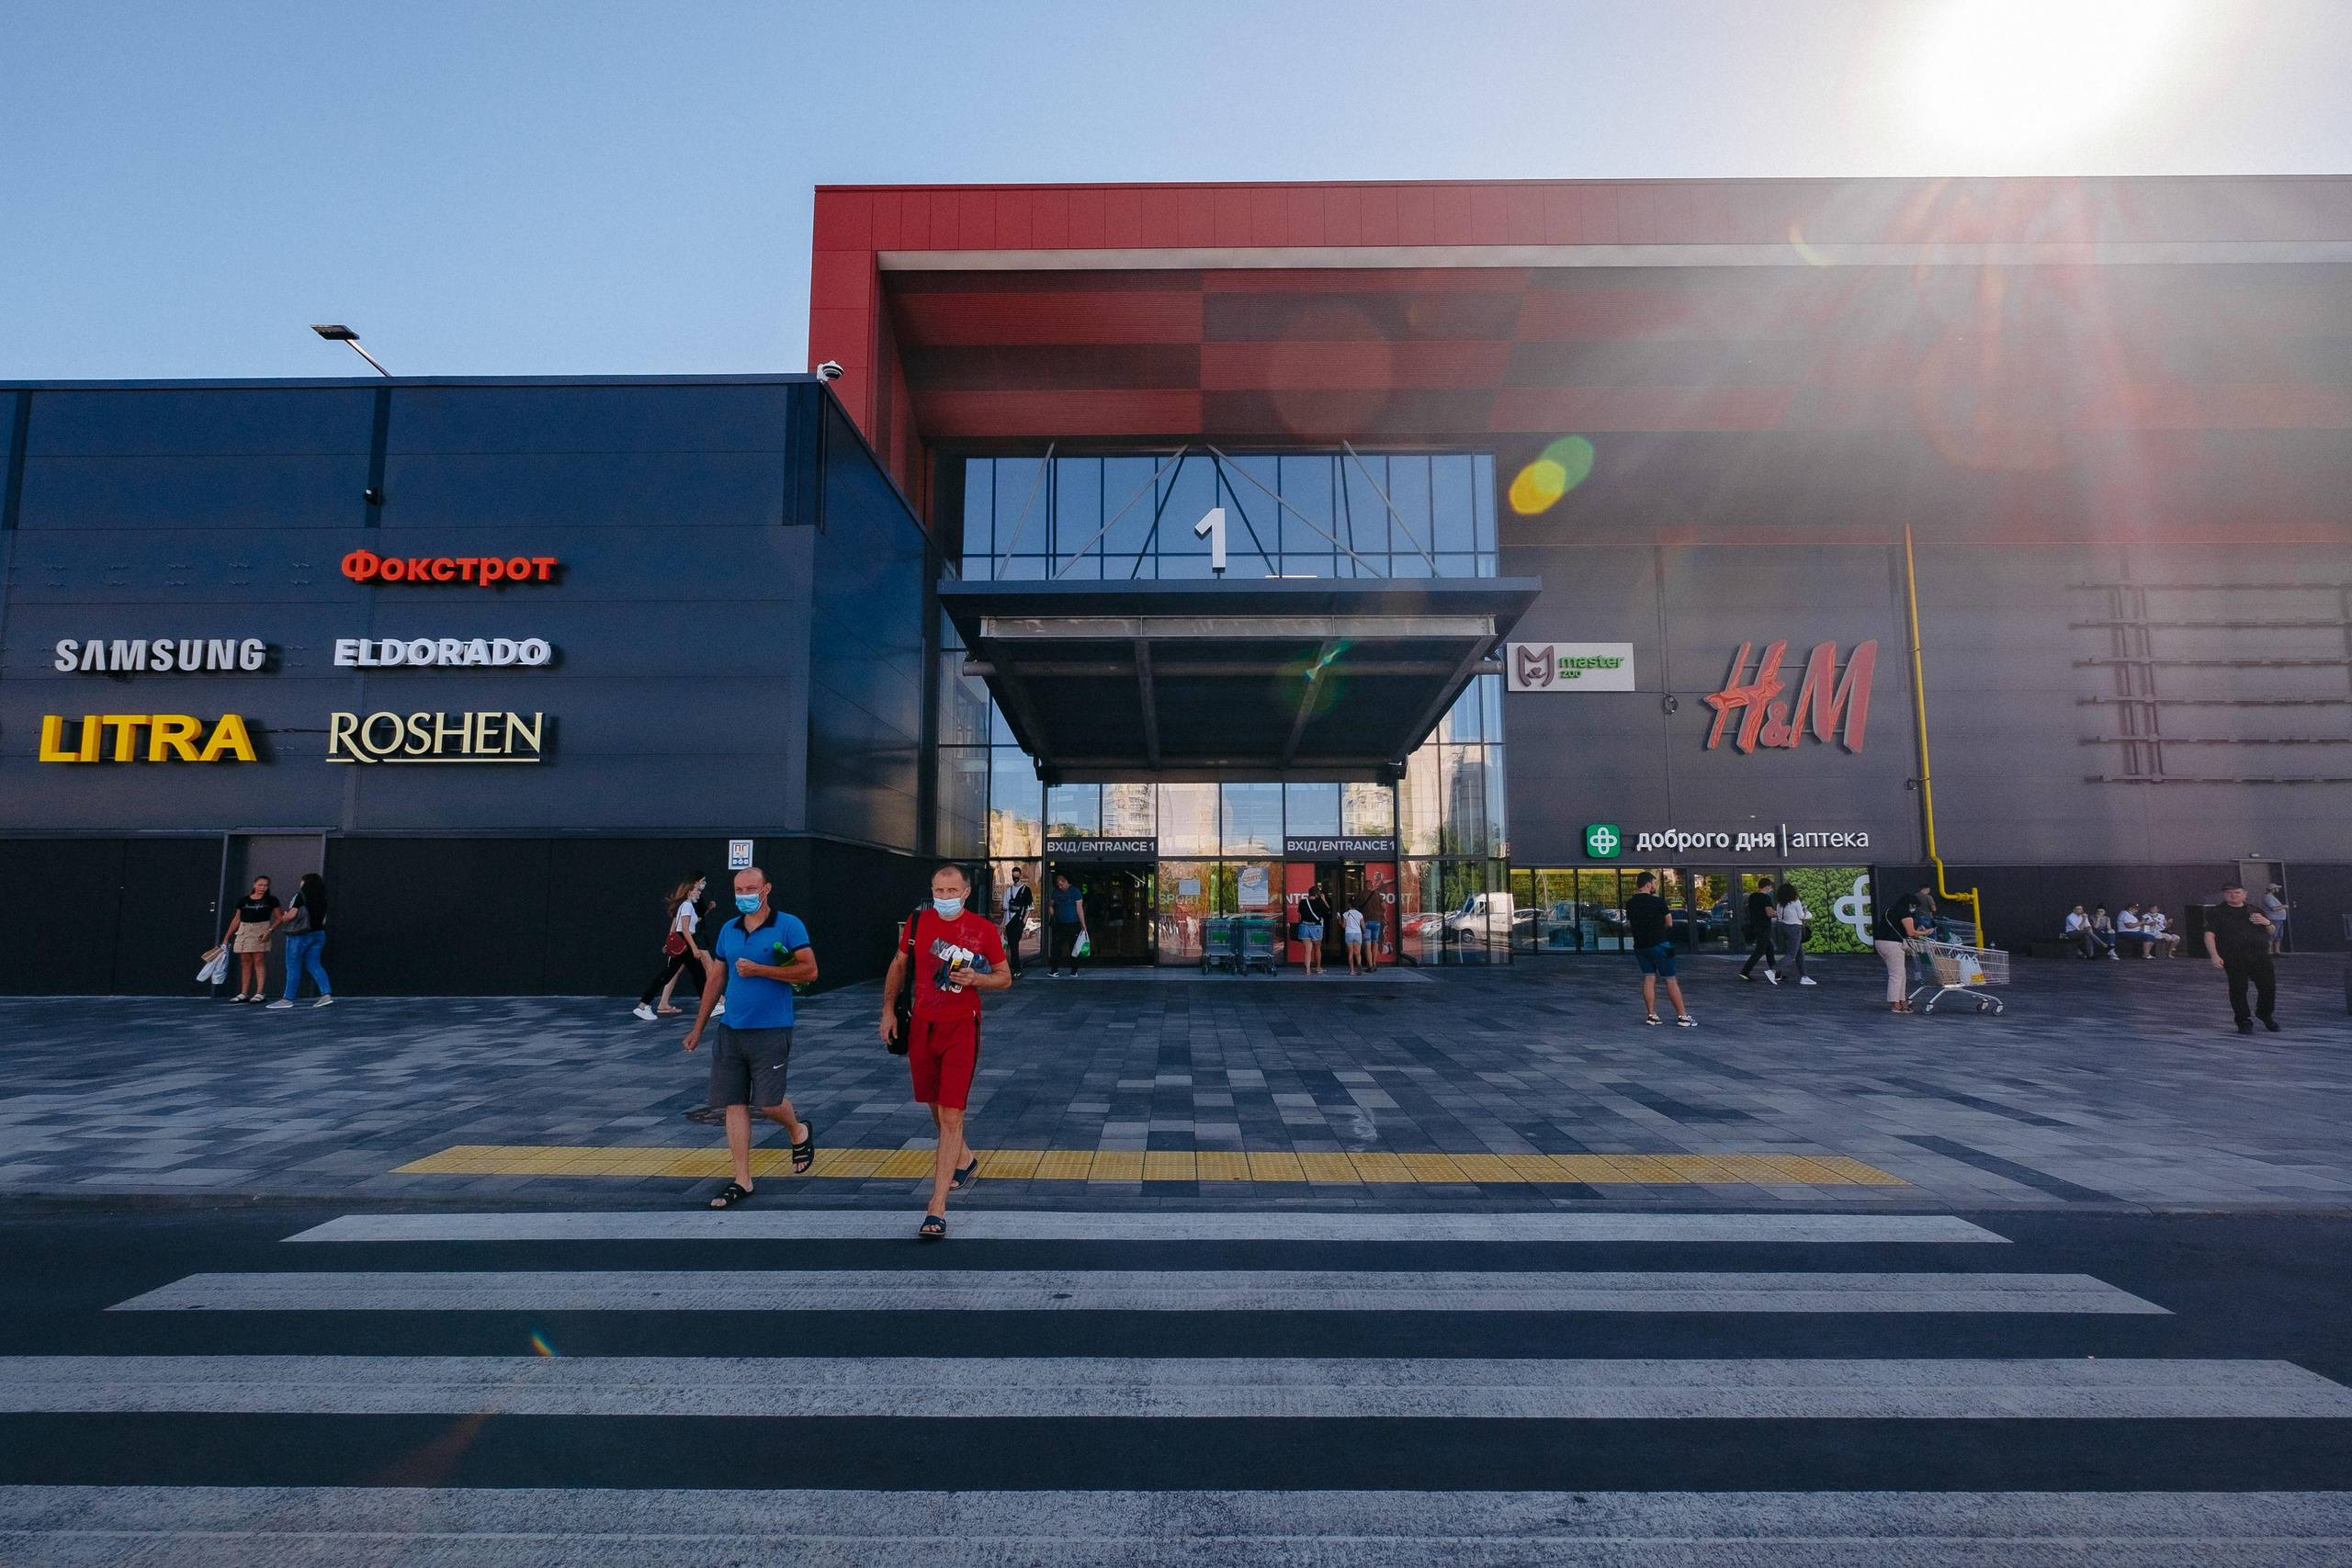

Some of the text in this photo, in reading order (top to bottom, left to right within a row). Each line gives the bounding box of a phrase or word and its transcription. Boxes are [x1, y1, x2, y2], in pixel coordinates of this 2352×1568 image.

[1194, 508, 1227, 573] 1
[341, 549, 557, 586] Фокстрот
[55, 638, 266, 671] SAMSUNG
[334, 637, 552, 667] ELDORADO
[1559, 655, 1625, 669] master
[1560, 670, 1583, 679] zoo
[1703, 639, 1878, 753] H&M
[39, 714, 257, 762] LITRA
[326, 711, 544, 763] ROSHEN
[1148, 841, 1155, 852] 1
[1389, 840, 1395, 851] 1
[1636, 829, 1870, 852] доброго дня аптека
